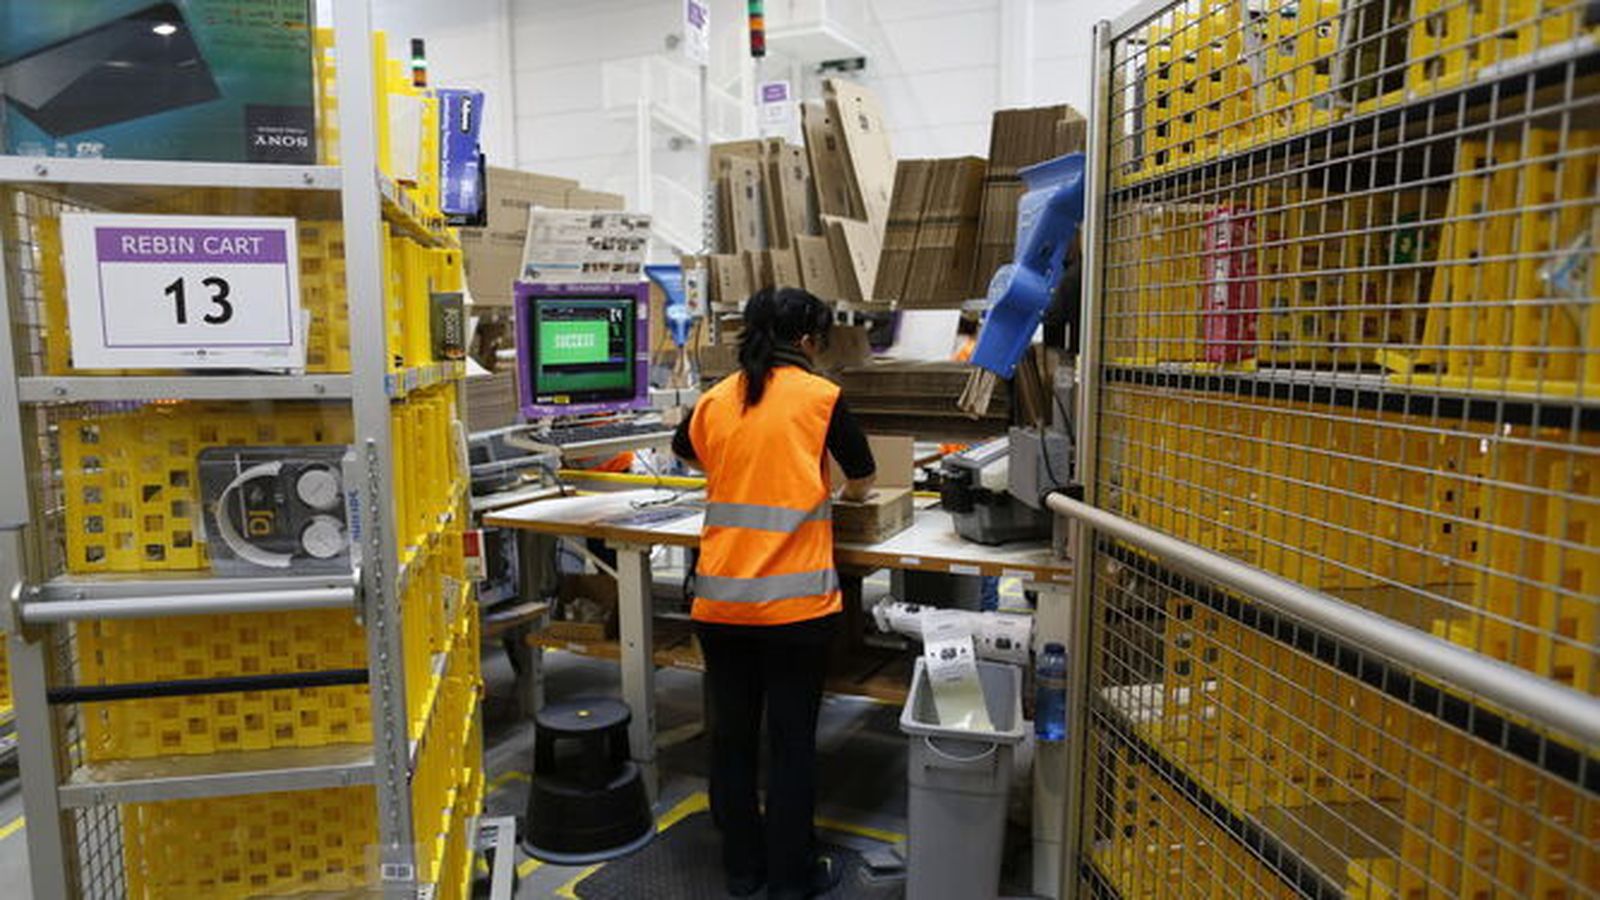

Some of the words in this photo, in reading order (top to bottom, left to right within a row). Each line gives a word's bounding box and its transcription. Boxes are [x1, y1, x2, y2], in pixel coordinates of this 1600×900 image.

[254, 135, 309, 148] SONY
[121, 235, 195, 254] REBIN
[203, 236, 264, 255] CART
[164, 276, 234, 325] 13
